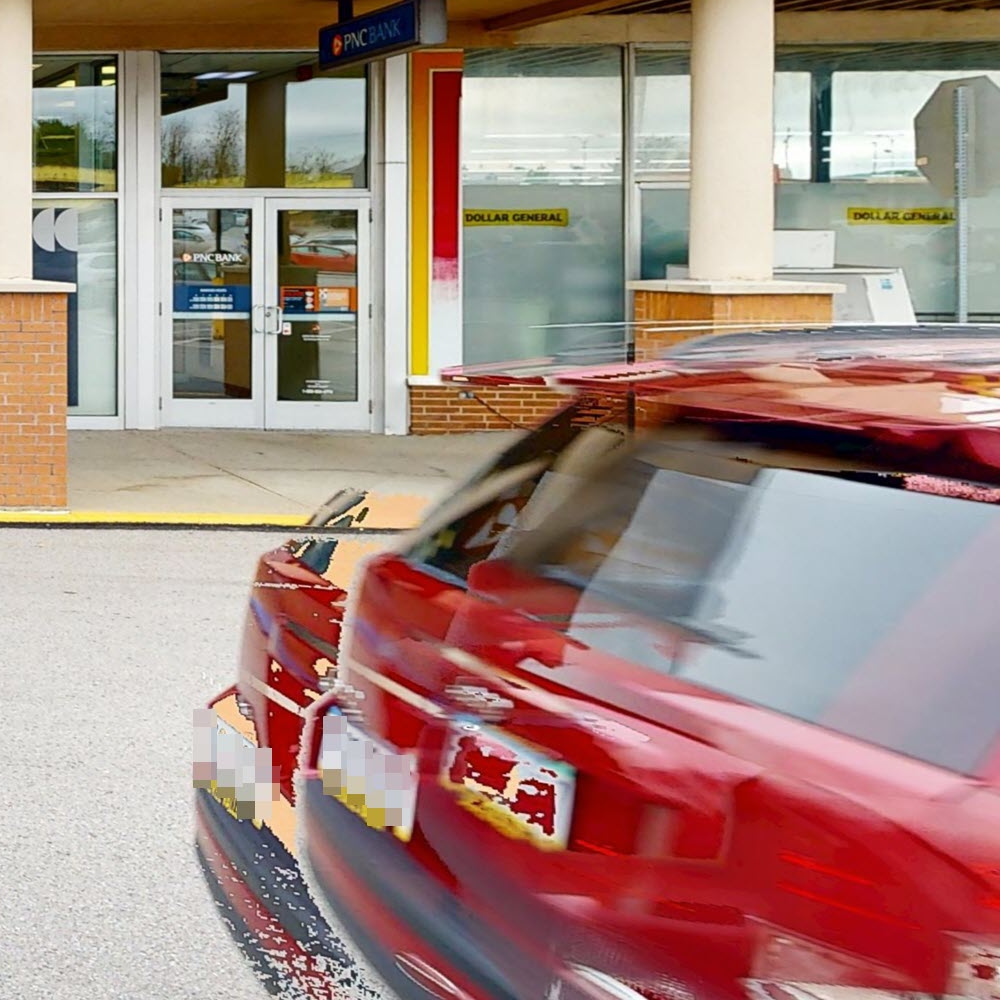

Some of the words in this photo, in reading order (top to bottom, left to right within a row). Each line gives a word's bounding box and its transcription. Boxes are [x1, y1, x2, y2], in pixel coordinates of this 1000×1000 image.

[344, 28, 368, 51] PNC
[369, 18, 401, 44] BANK
[466, 213, 509, 222] DOLLAR
[512, 213, 563, 222] GENERAL
[854, 212, 900, 220] DOLLAR
[193, 253, 215, 262] PNC
[215, 253, 243, 262] BANK
